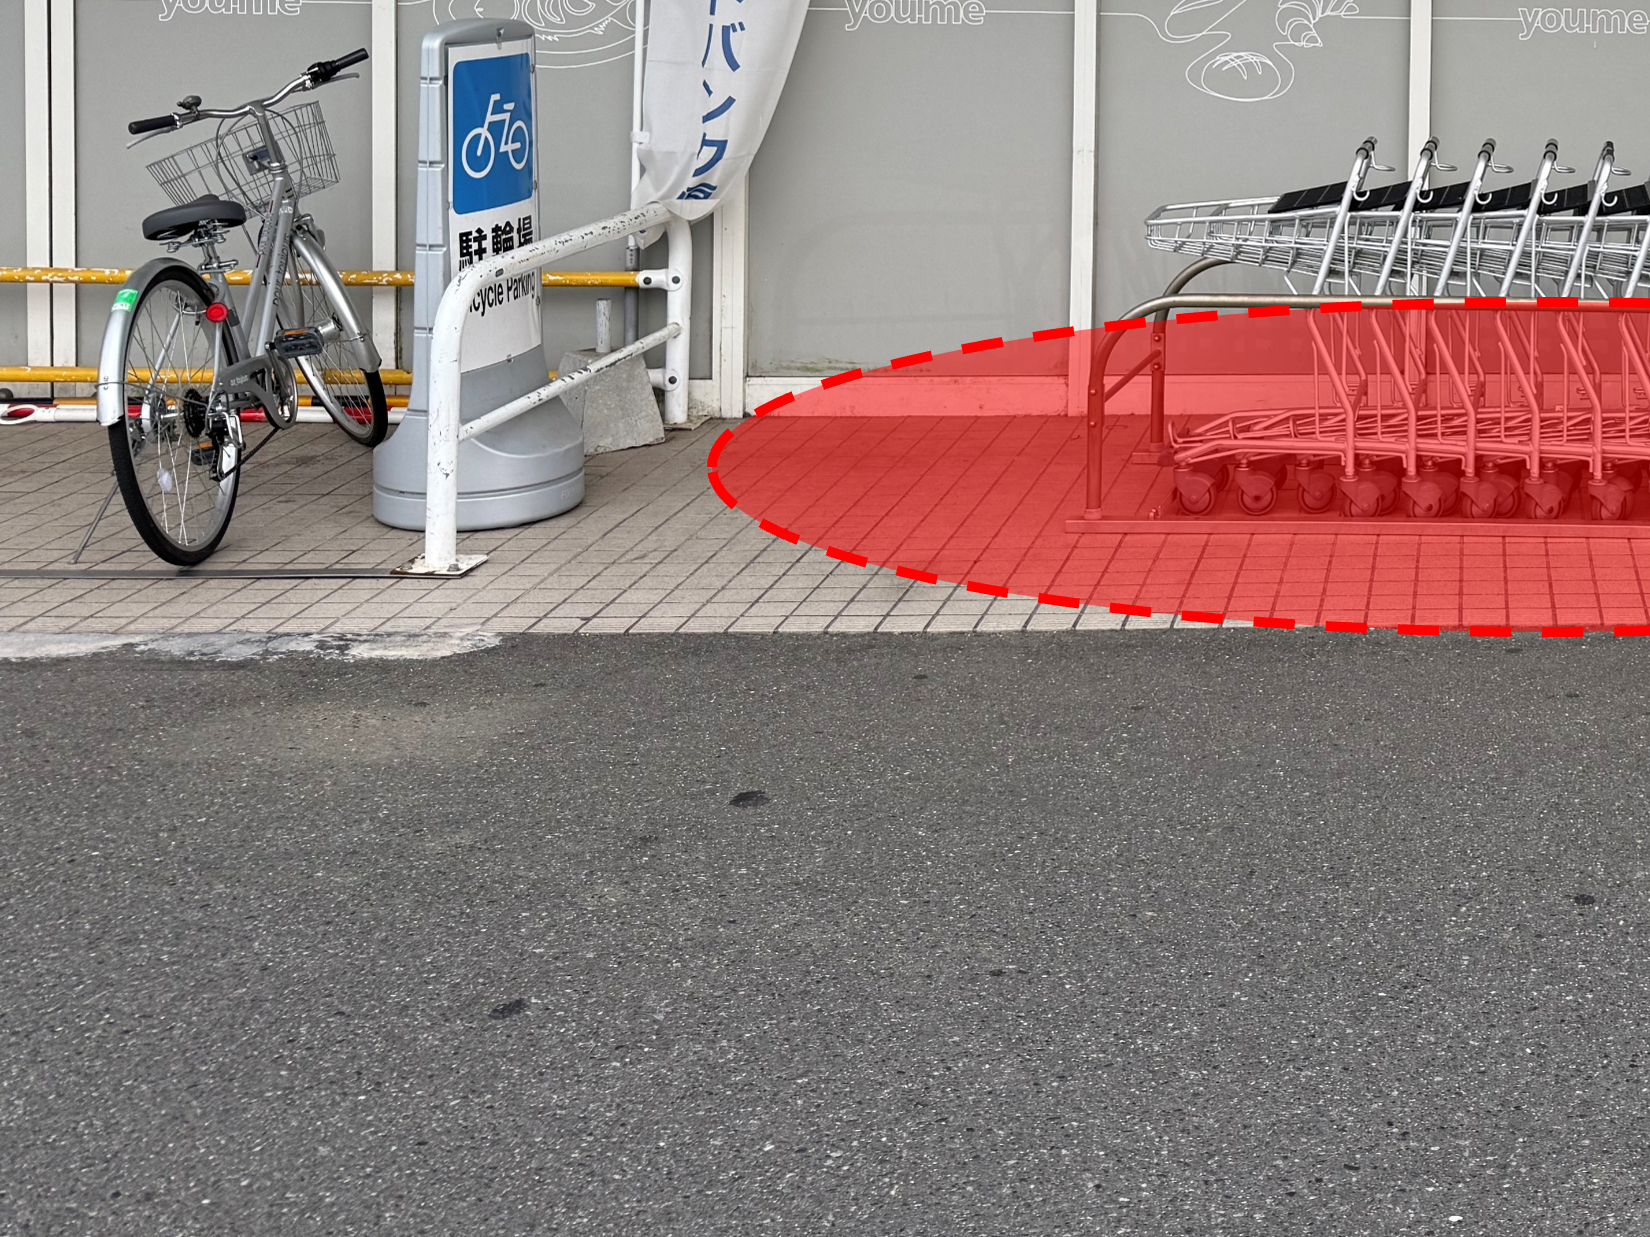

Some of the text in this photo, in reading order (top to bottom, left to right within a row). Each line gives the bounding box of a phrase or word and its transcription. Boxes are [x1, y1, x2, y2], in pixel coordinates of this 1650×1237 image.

[1518, 8, 1649, 40] youme
[459, 215, 534, 272] 駐輪場
[469, 271, 536, 317] cycle Parking
